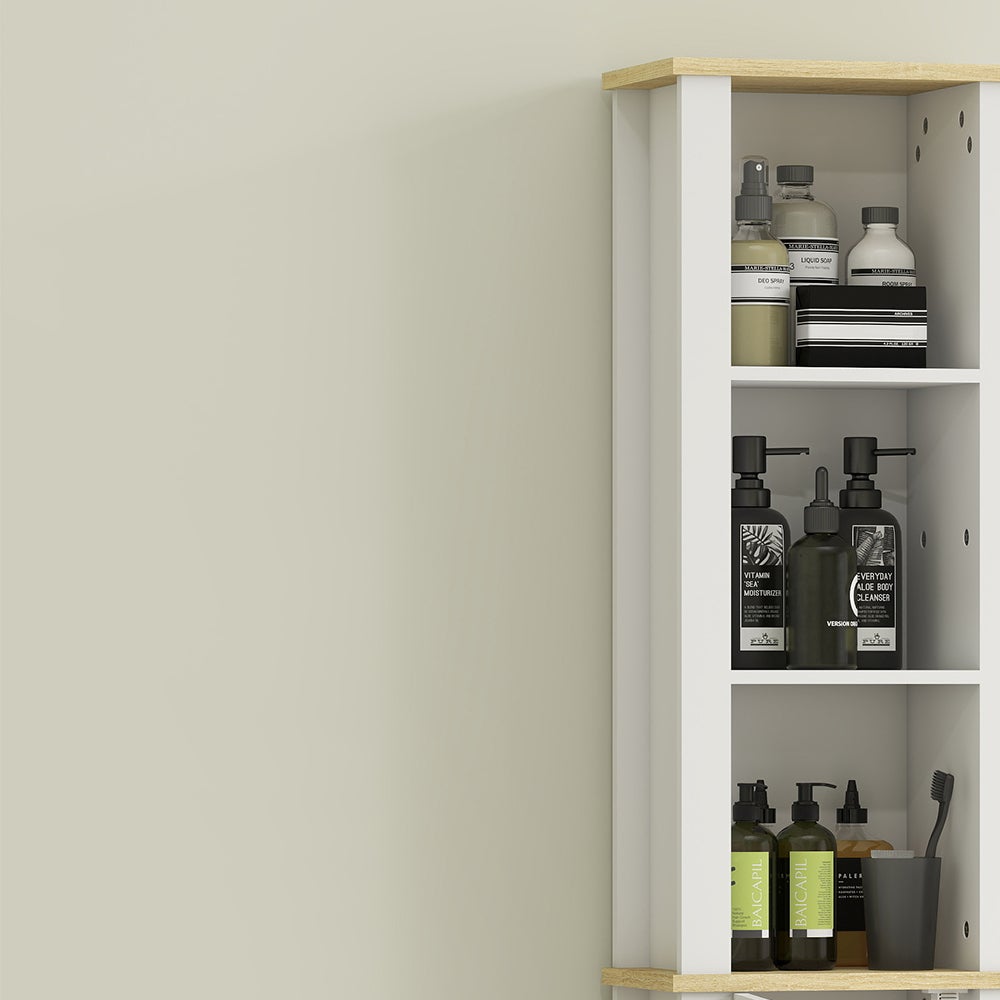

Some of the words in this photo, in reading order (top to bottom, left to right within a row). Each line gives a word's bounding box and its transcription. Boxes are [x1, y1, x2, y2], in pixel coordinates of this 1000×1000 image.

[789, 262, 795, 270] 3
[743, 571, 771, 579] VITAMIN
[856, 572, 893, 581] EVERYDAY
[856, 582, 875, 591] ALOE
[876, 582, 894, 591] BODY
[743, 589, 782, 597] MOISTURIZER
[857, 593, 890, 602] CLEANSER
[751, 858, 763, 927] BAICAPIL
[794, 858, 808, 927] BAICAPIL
